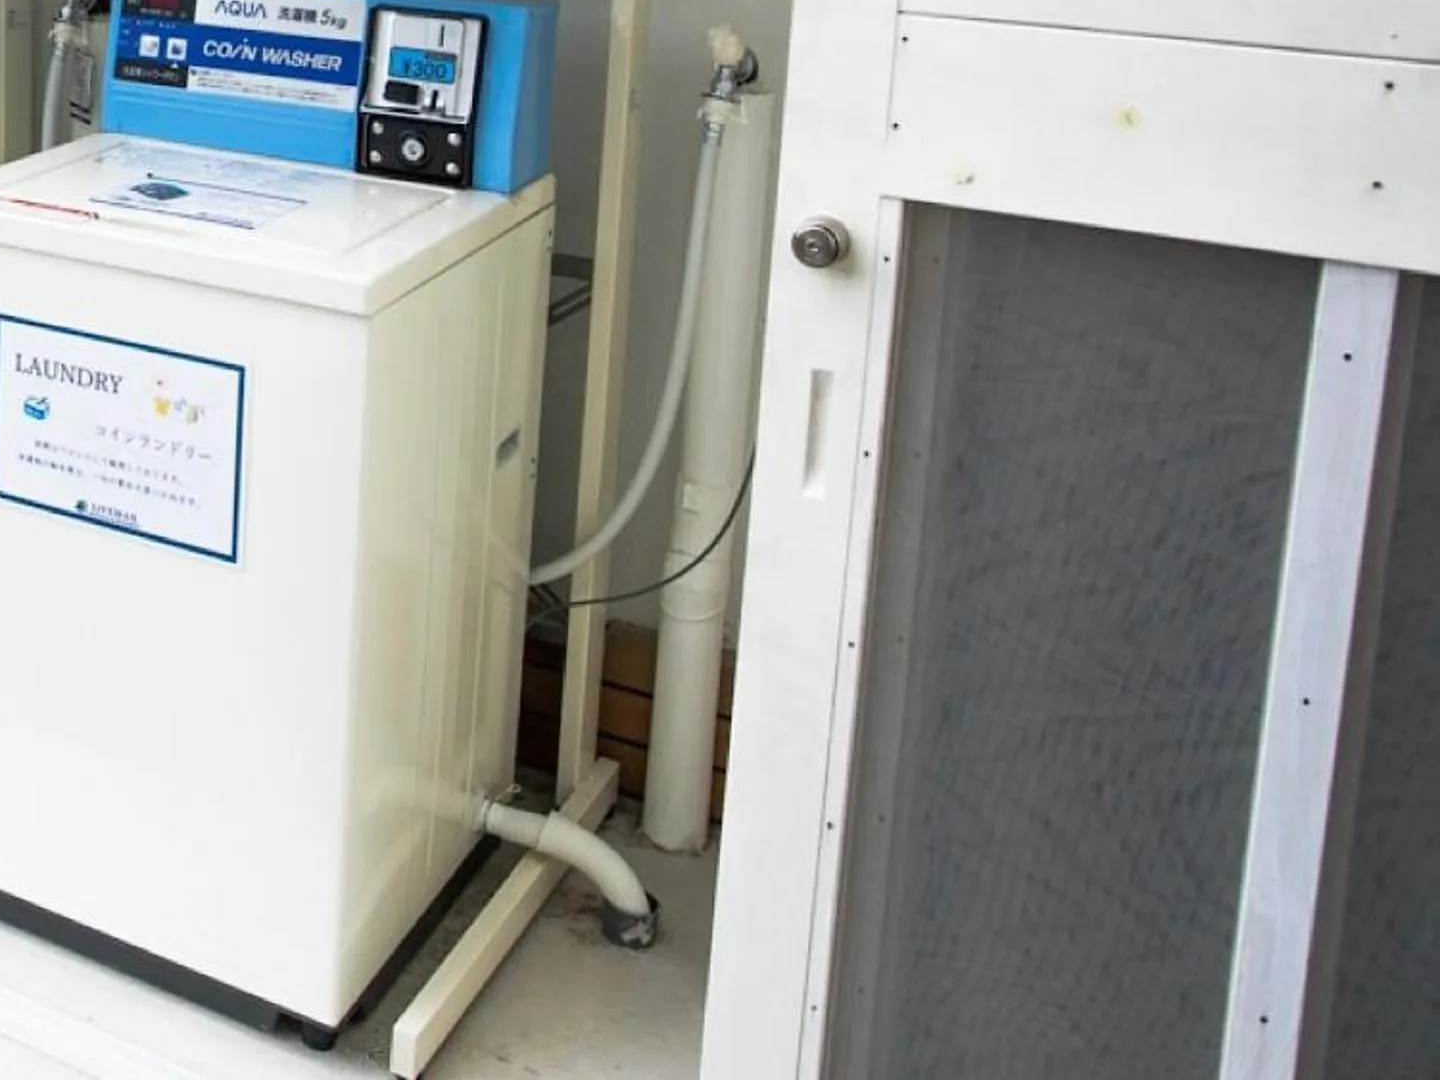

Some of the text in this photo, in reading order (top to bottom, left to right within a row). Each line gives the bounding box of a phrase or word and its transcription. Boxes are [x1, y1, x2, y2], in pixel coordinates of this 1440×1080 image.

[215, 0, 266, 19] AQUA
[262, 46, 343, 72] WASHER
[15, 352, 124, 395] LAUNDRY
[95, 424, 213, 461] コインランドリー
